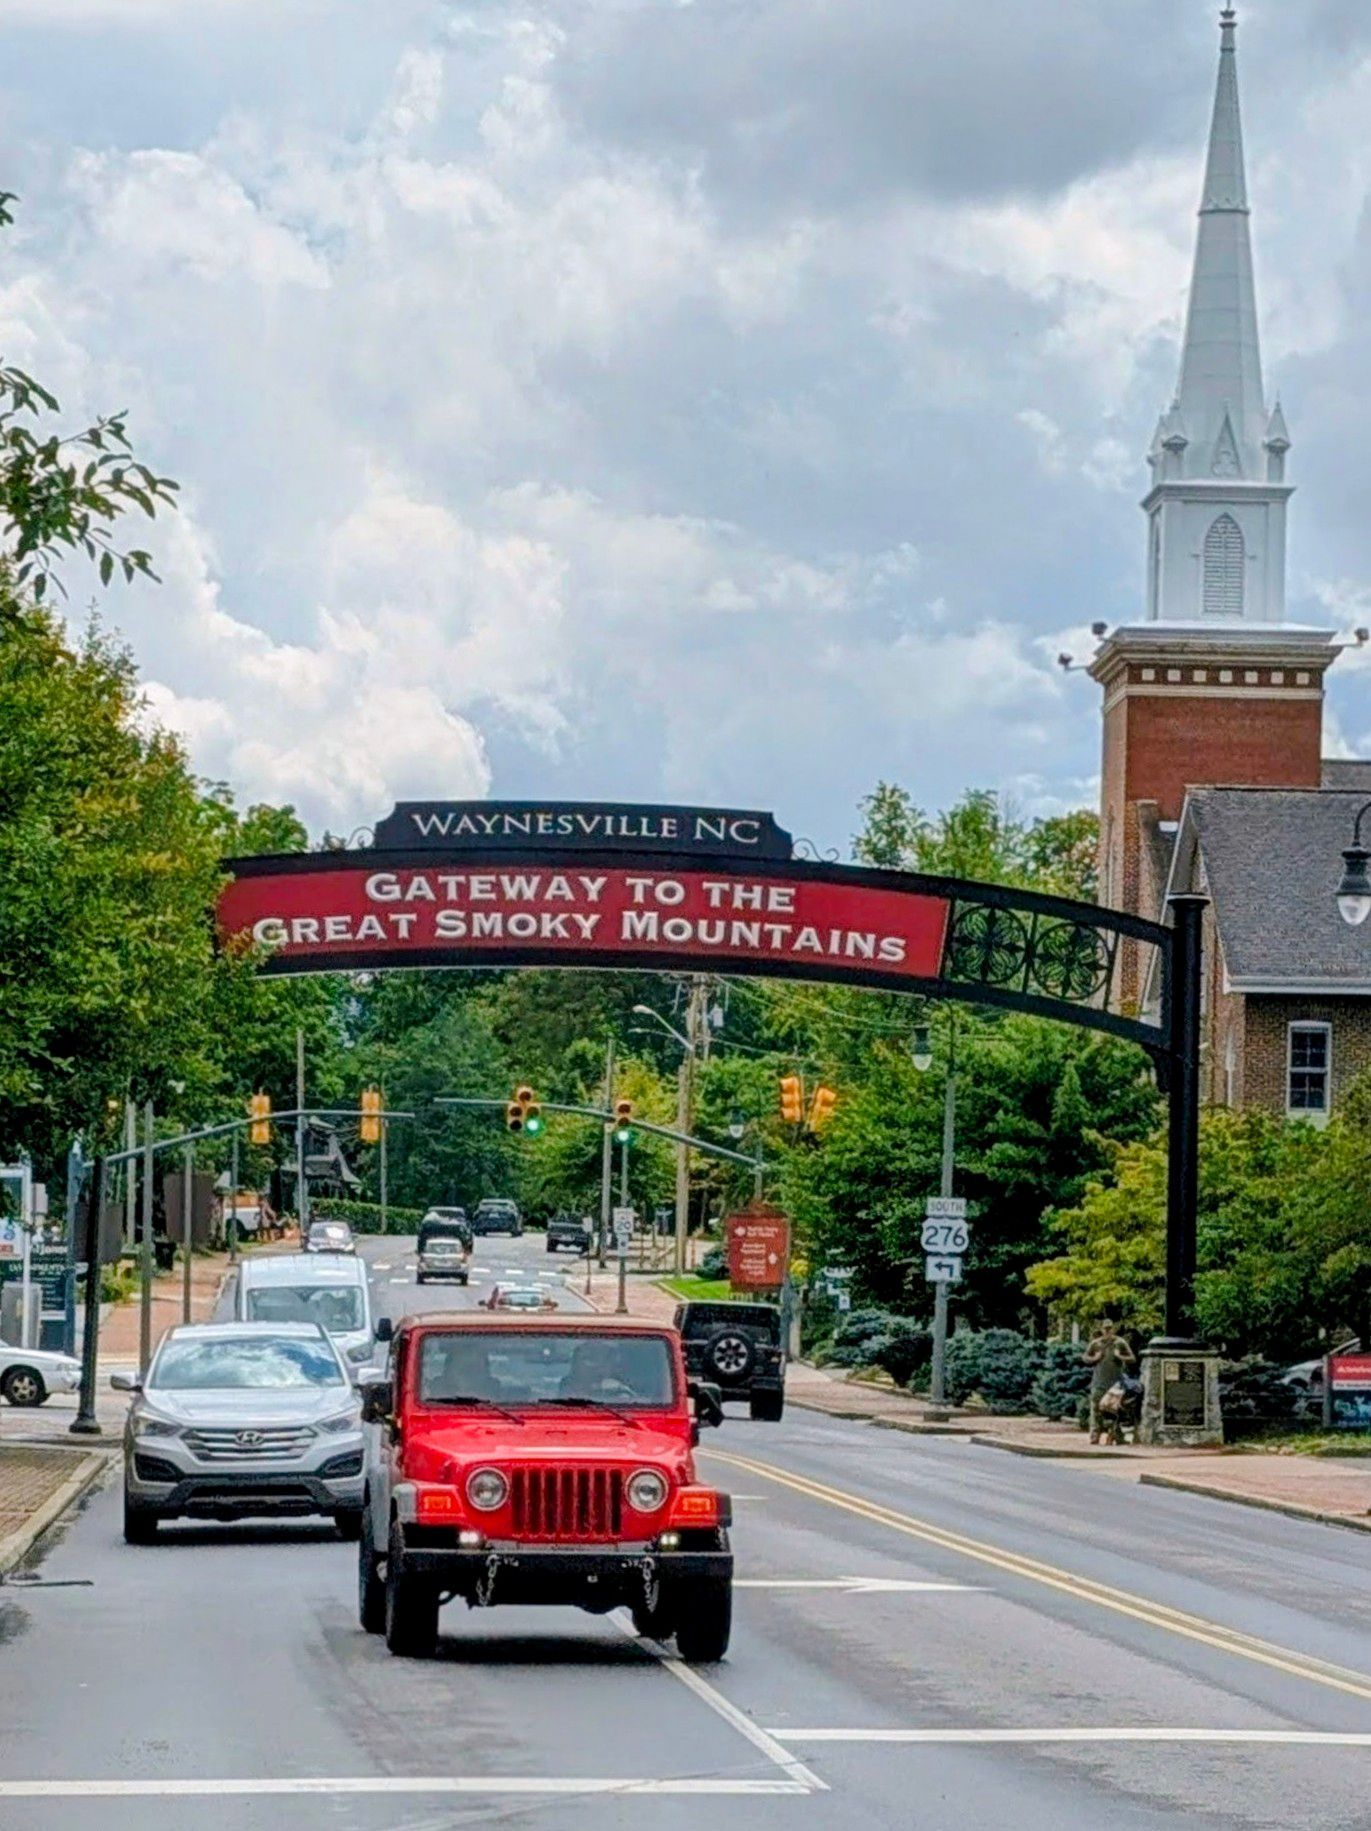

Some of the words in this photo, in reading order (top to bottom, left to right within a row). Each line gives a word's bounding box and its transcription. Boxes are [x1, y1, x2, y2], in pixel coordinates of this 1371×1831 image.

[411, 813, 678, 838] WAYNESVILLE
[693, 817, 760, 844] NC
[365, 872, 607, 902] GATEWAY
[625, 877, 686, 906] TO
[702, 881, 796, 914] THE
[253, 912, 418, 945] GREAT
[435, 909, 601, 940] SMOKY
[620, 910, 906, 961] MOUNTAINS
[930, 1200, 963, 1212] SOUTH
[925, 1225, 966, 1247] 276
